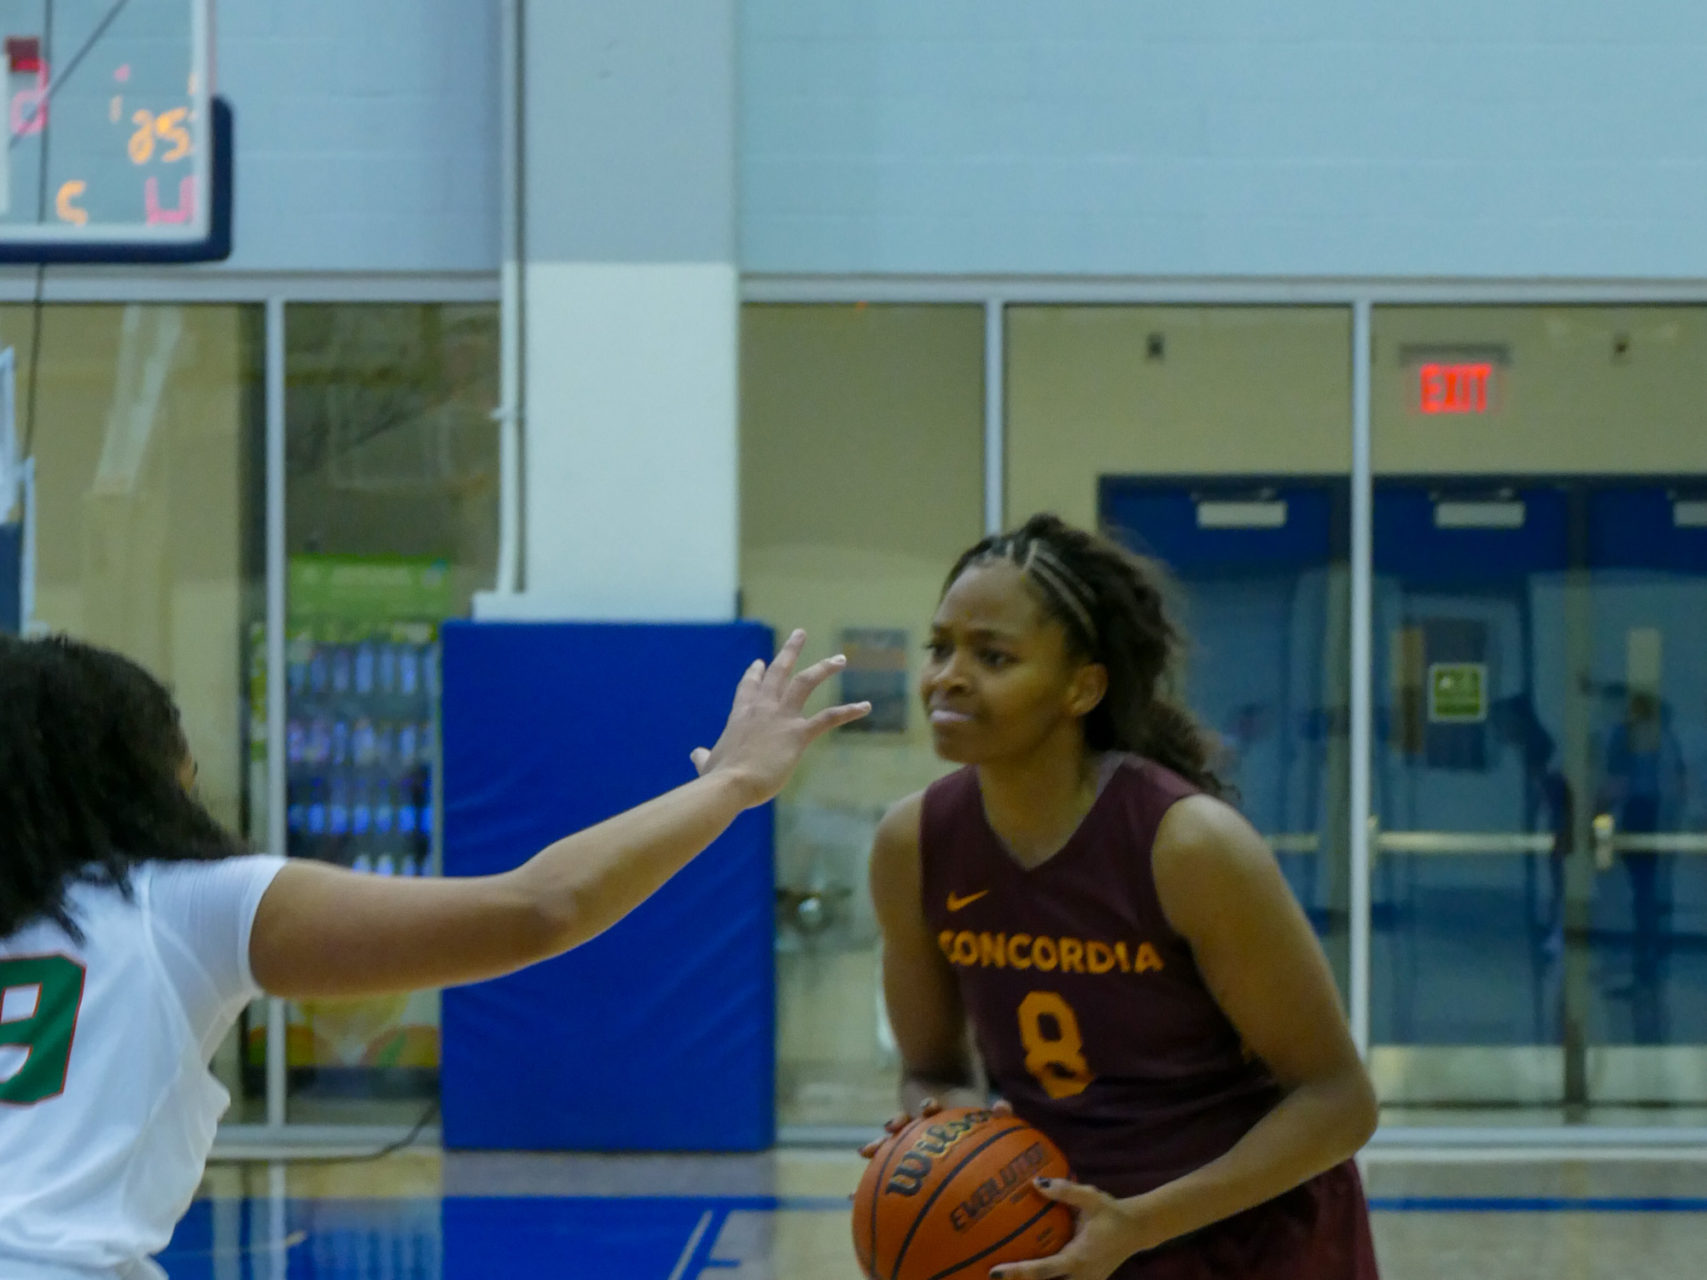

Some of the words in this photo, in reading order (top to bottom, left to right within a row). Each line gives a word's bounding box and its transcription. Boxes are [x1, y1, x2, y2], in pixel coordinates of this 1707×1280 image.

[1419, 364, 1492, 413] EXIT
[938, 930, 1164, 973] CONCORDIA
[1017, 991, 1096, 1099] 8
